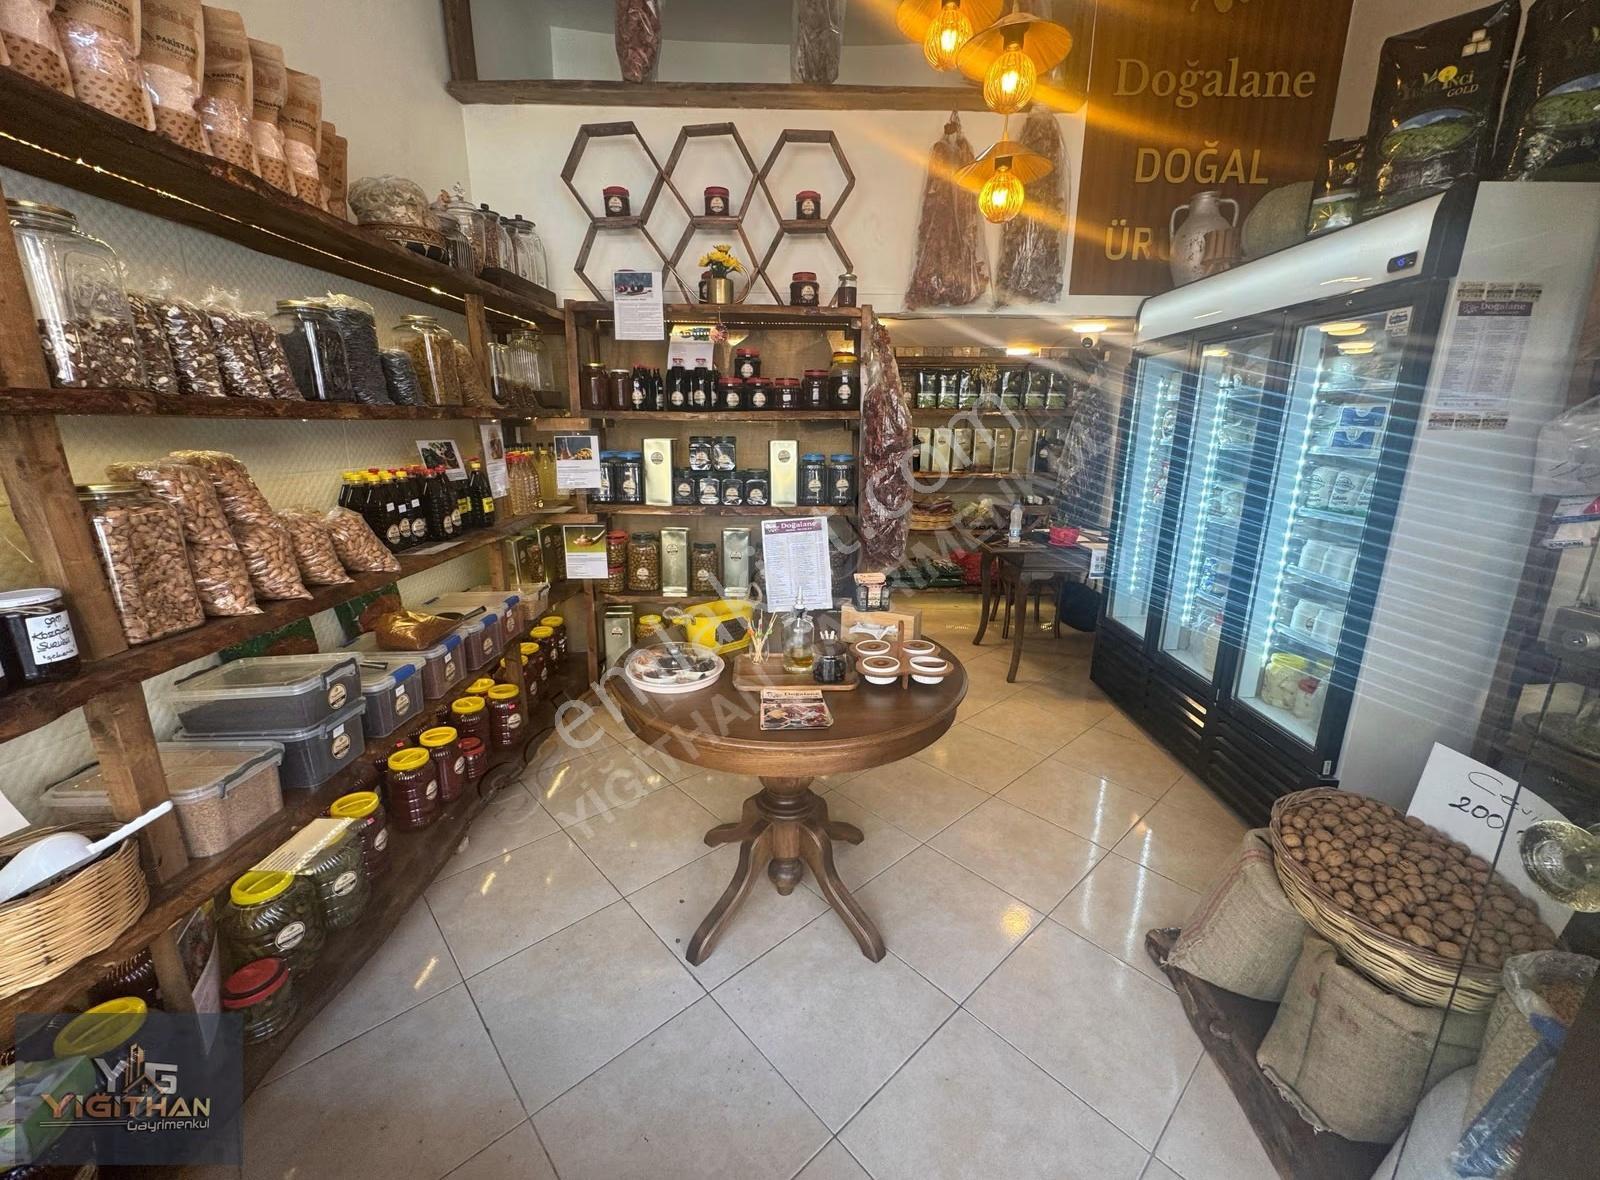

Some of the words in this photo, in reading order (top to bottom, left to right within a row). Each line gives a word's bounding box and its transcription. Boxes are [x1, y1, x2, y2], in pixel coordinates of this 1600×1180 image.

[1113, 57, 1316, 108] Doğalane
[1447, 84, 1479, 97] GOLD
[1135, 140, 1269, 184] DOĞAL
[1448, 796, 1505, 829] 200
